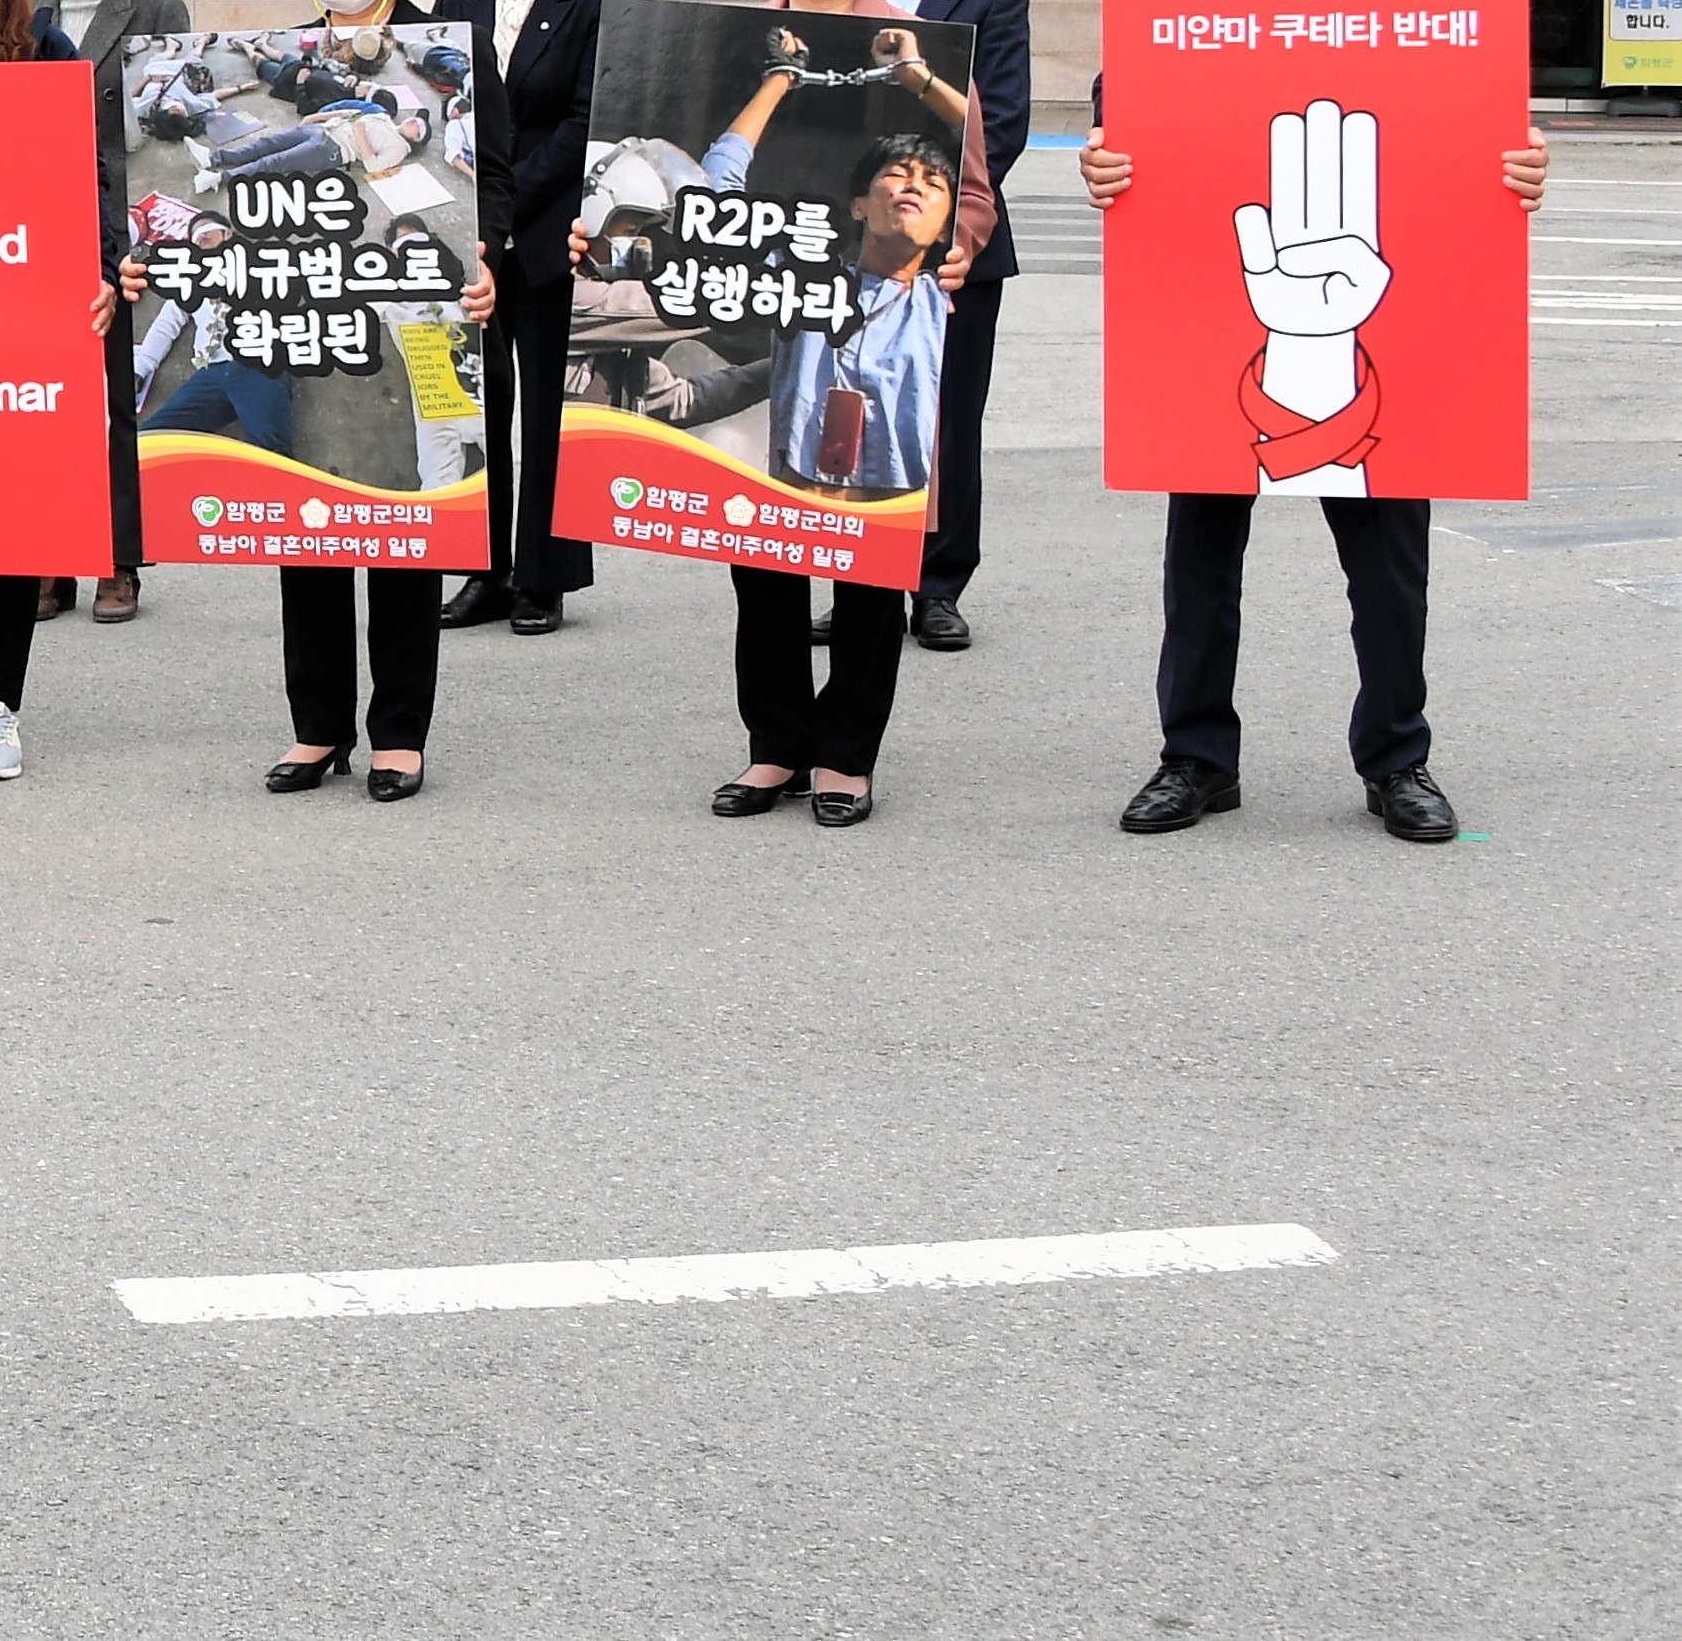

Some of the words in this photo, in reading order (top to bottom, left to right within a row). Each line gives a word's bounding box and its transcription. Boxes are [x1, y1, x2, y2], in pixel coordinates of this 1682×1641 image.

[1153, 14, 1261, 50] 미얀마
[1270, 12, 1382, 48] 쿠테타
[1394, 10, 1477, 46] 반대!
[1626, 14, 1670, 29] 합니다.
[235, 177, 356, 230] UN은
[680, 193, 839, 264] R2P를
[148, 244, 452, 302] 국제규범으로
[652, 260, 854, 336] 실행하라
[230, 309, 369, 367] 확립된
[225, 501, 286, 523] 함평군
[333, 503, 432, 526] 함평군의회
[646, 486, 709, 517] 함평군
[759, 501, 865, 539] 함평군의회
[198, 533, 256, 554] 동남아
[262, 533, 381, 556] 결혼이주여성
[387, 536, 428, 559] 일동
[612, 515, 675, 543] 동남아
[680, 522, 804, 564] 결혼이주여성
[812, 546, 854, 572] 일동
